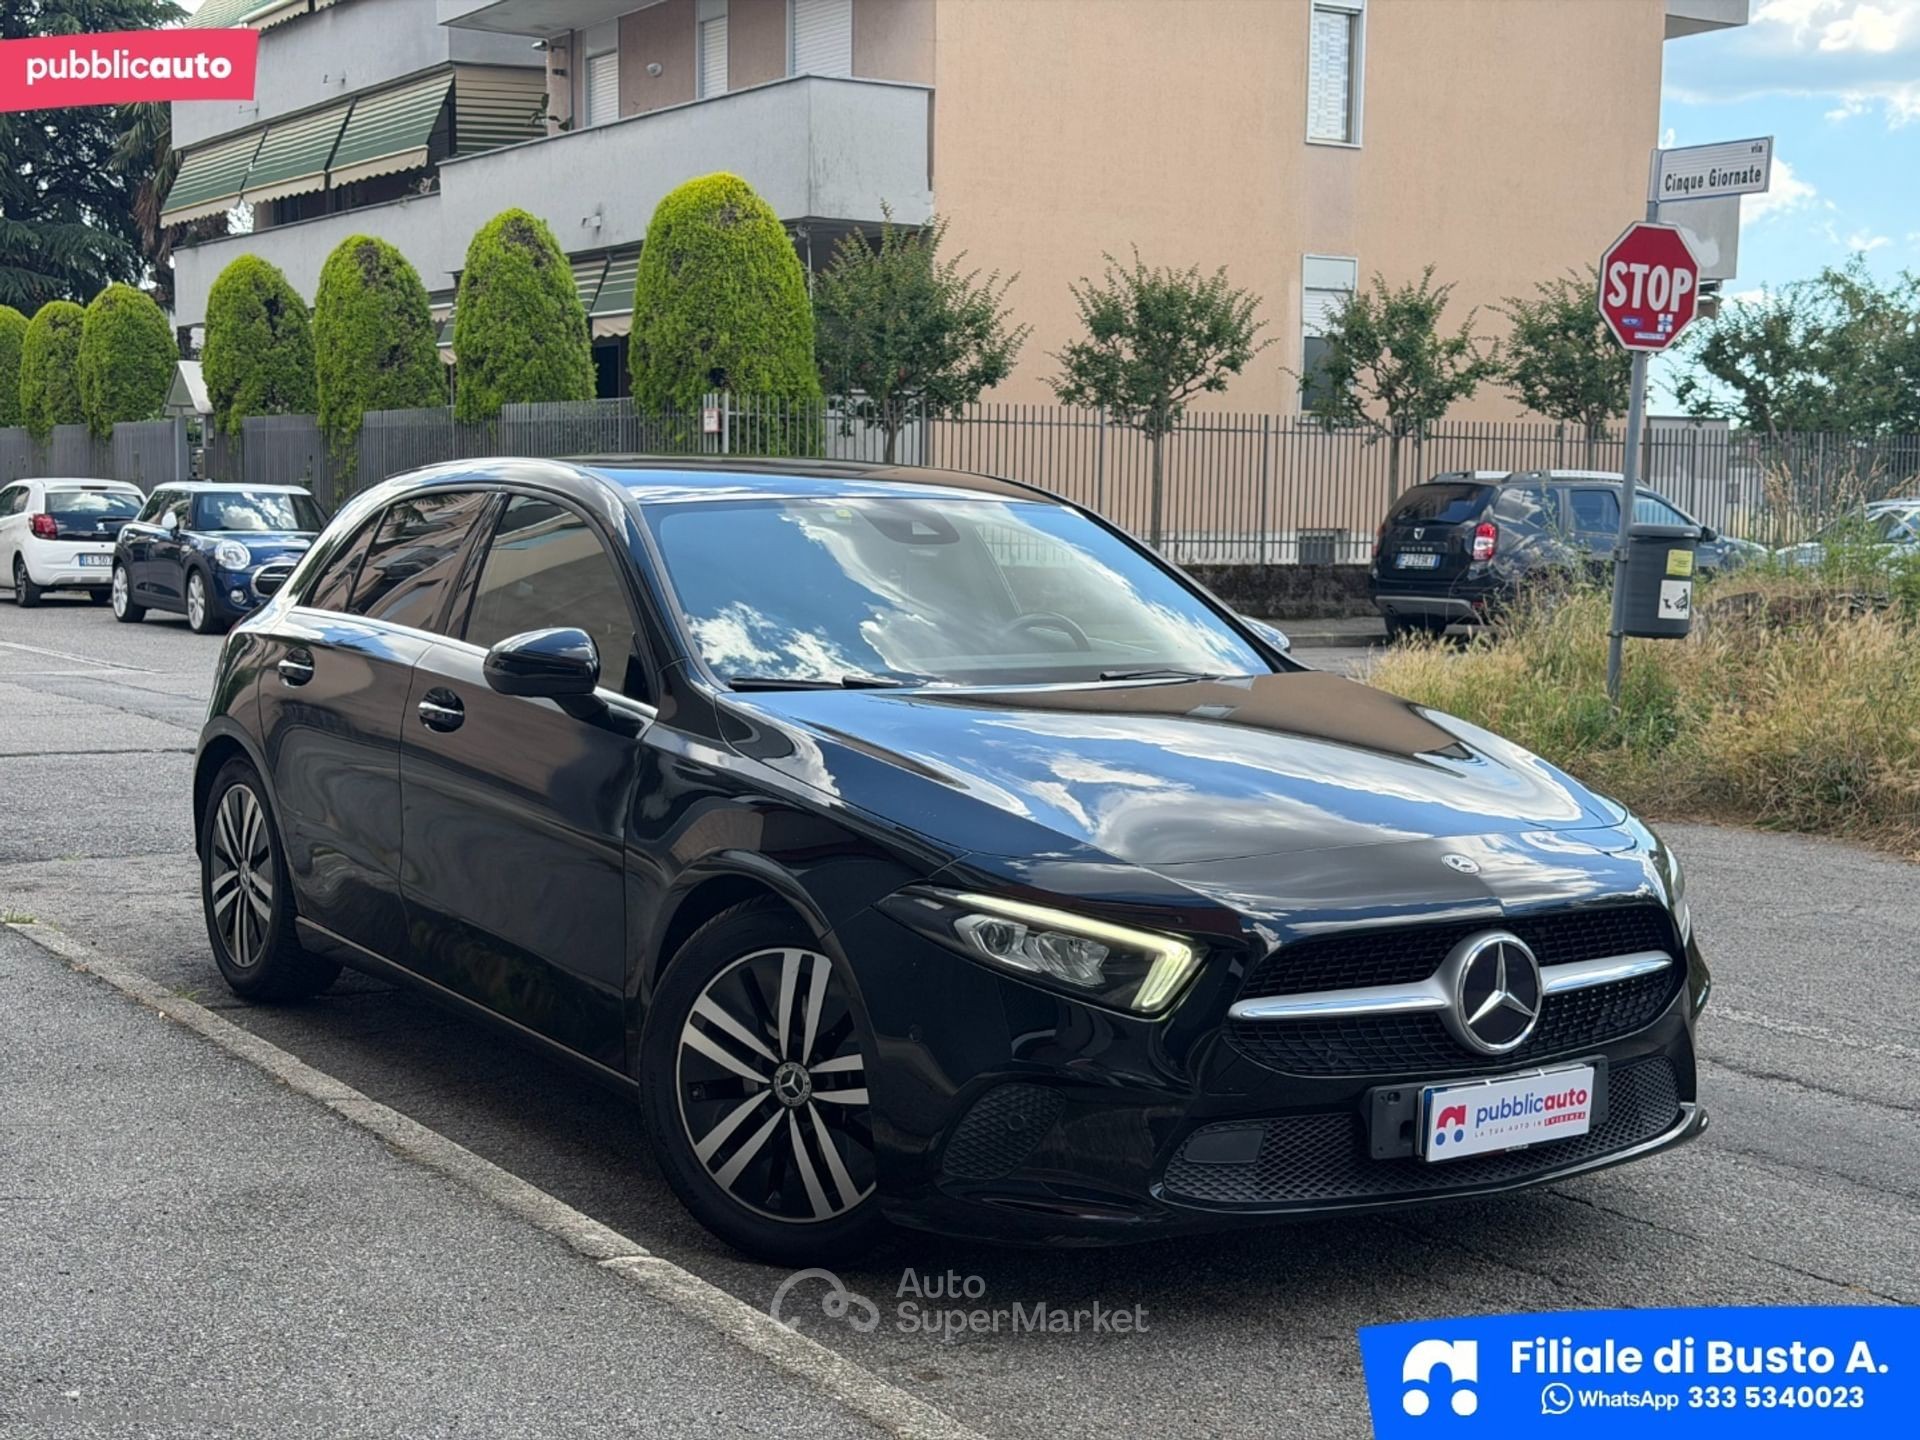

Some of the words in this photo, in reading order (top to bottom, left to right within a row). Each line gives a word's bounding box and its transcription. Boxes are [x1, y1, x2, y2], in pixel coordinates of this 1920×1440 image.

[1750, 143, 1763, 153] via
[1664, 172, 1704, 194] Cinque
[1709, 165, 1762, 188] Giornate
[1607, 261, 1693, 312] STOP
[1475, 1087, 1588, 1128] pubblicauto
[1508, 1122, 1530, 1131] AUTO
